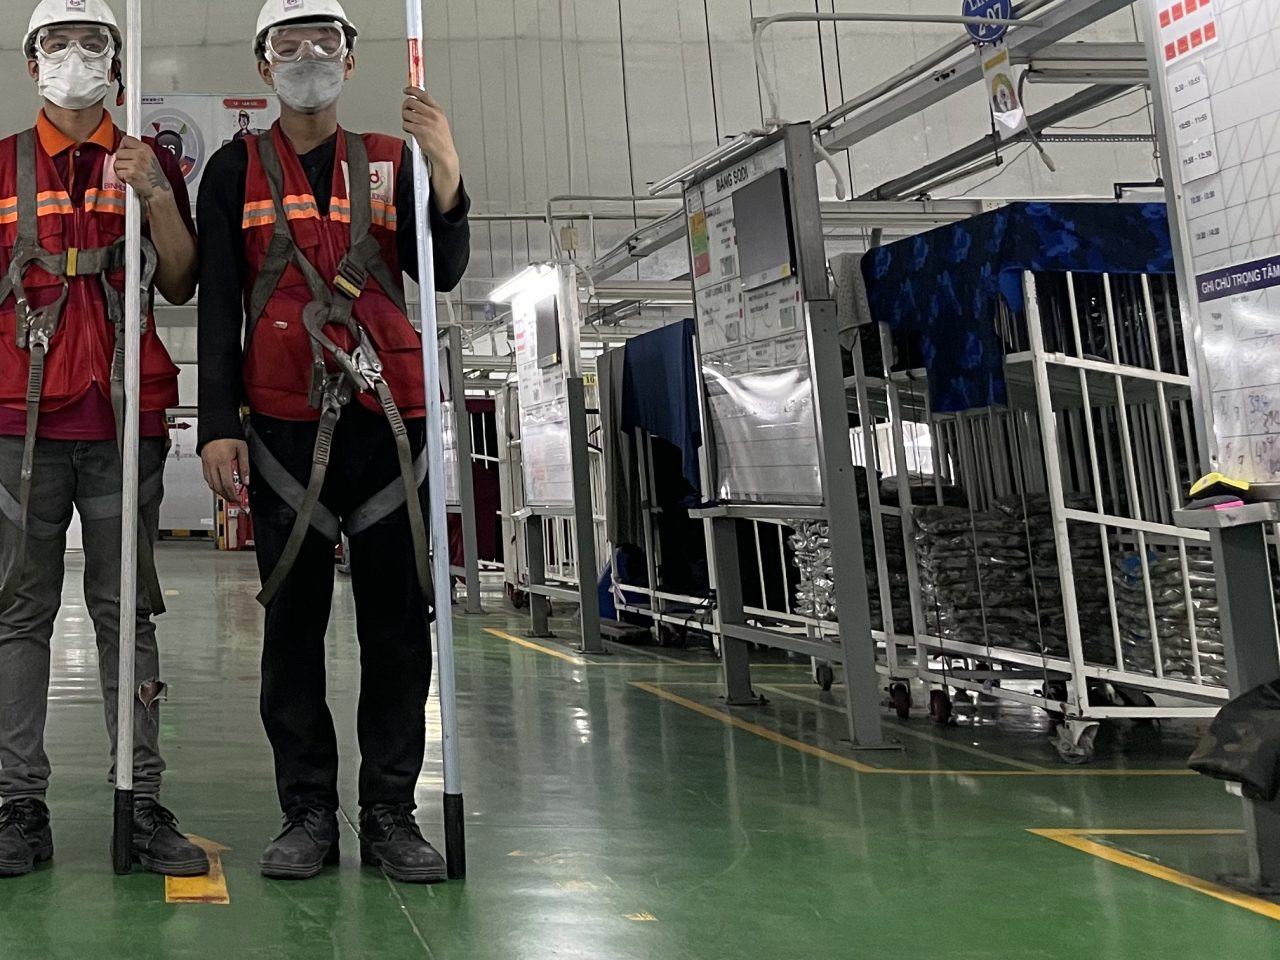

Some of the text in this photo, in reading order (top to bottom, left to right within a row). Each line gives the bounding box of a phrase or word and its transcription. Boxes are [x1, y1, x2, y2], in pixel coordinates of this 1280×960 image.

[1201, 280, 1215, 294] GHI
[1214, 272, 1231, 290] CHÚ
[1231, 269, 1261, 287] TRỌNG
